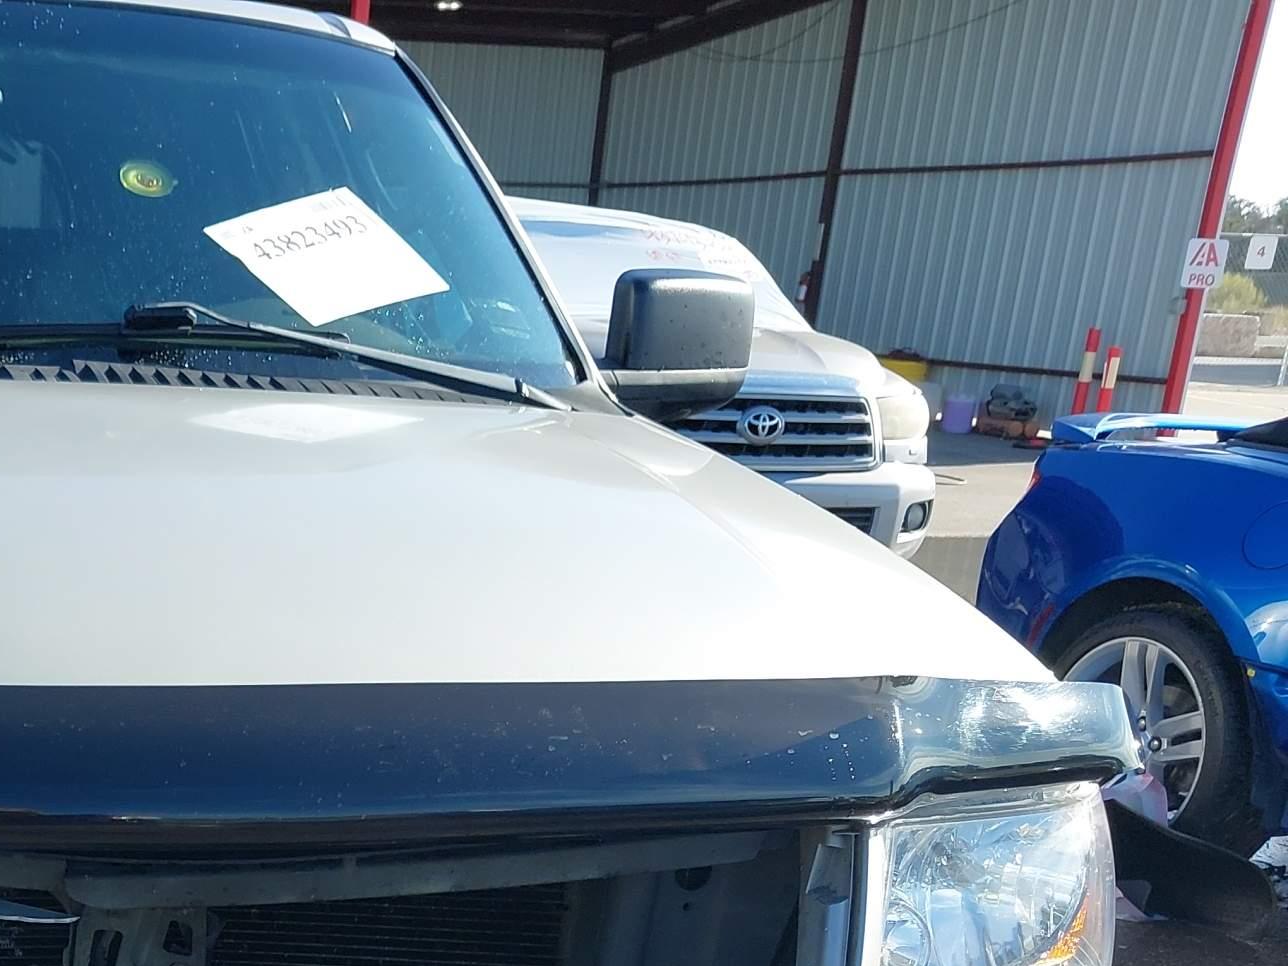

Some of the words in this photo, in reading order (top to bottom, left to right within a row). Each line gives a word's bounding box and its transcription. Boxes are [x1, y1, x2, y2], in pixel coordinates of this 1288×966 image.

[253, 215, 368, 260] 43823493
[1256, 245, 1266, 257] 4
[1187, 273, 1216, 287] PRO
